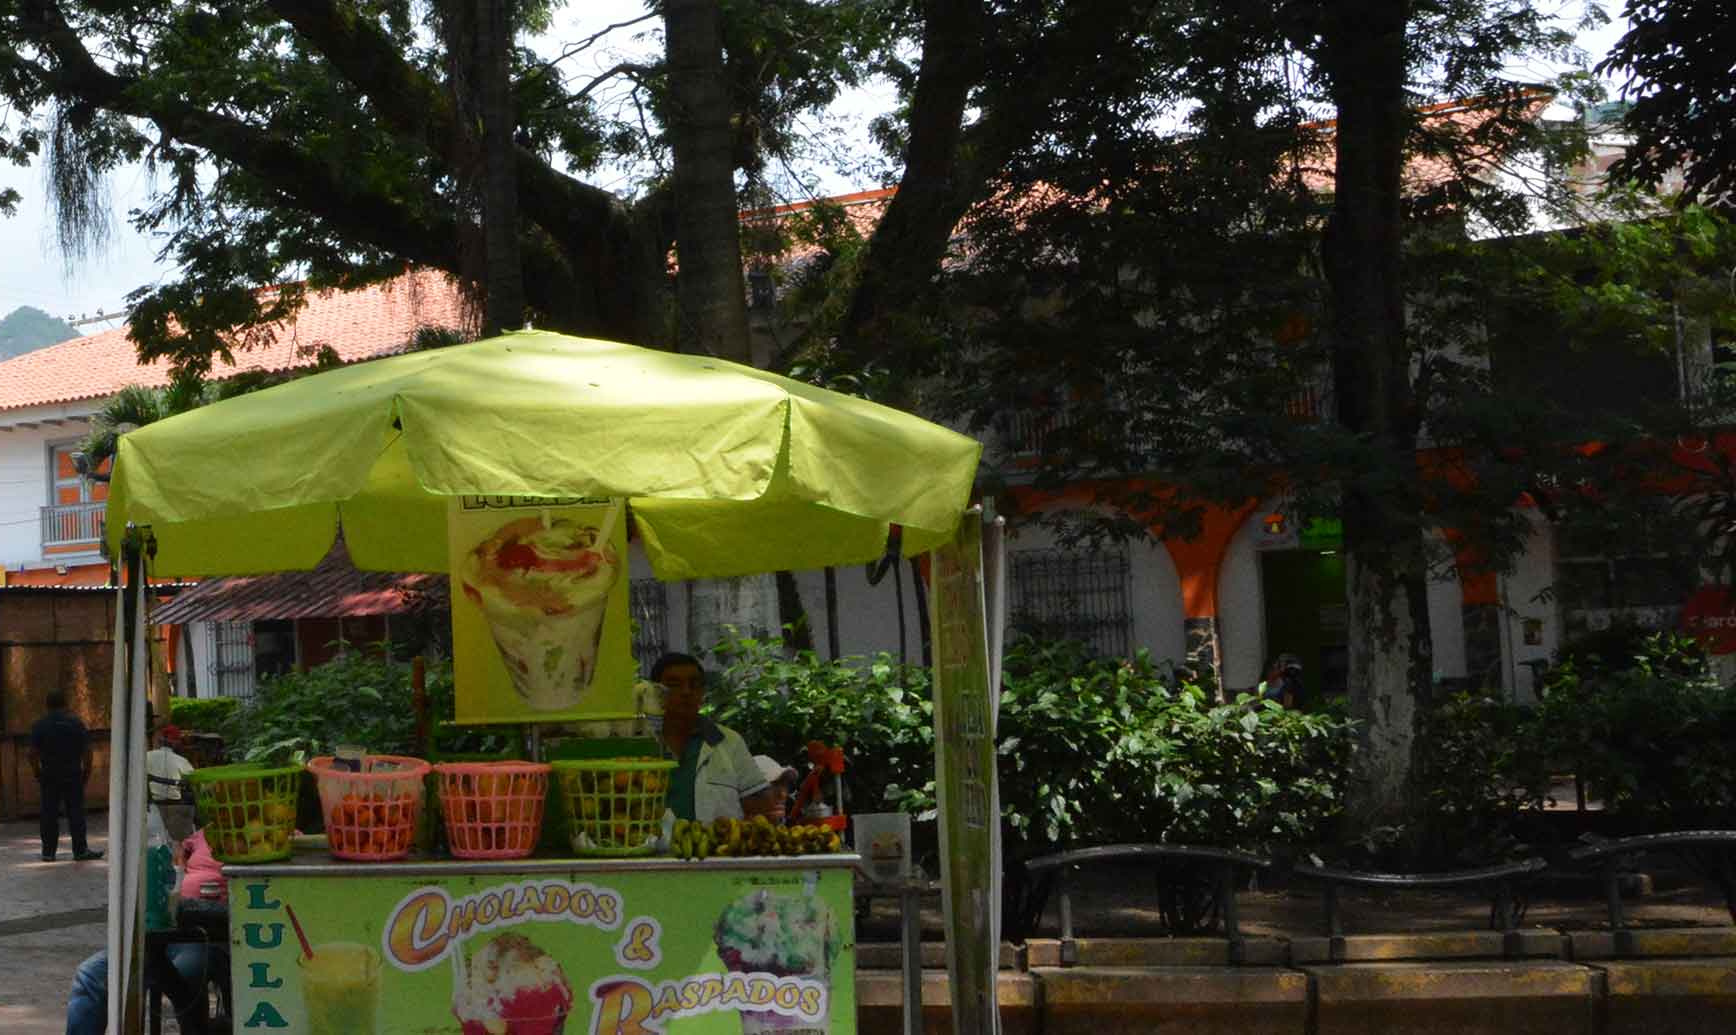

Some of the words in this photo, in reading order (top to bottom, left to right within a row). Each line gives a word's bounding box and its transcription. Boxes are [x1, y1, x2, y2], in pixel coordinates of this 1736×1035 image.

[388, 884, 618, 966] CHOLADOS
[622, 922, 655, 962] &
[595, 976, 822, 1035] RASPADOS
